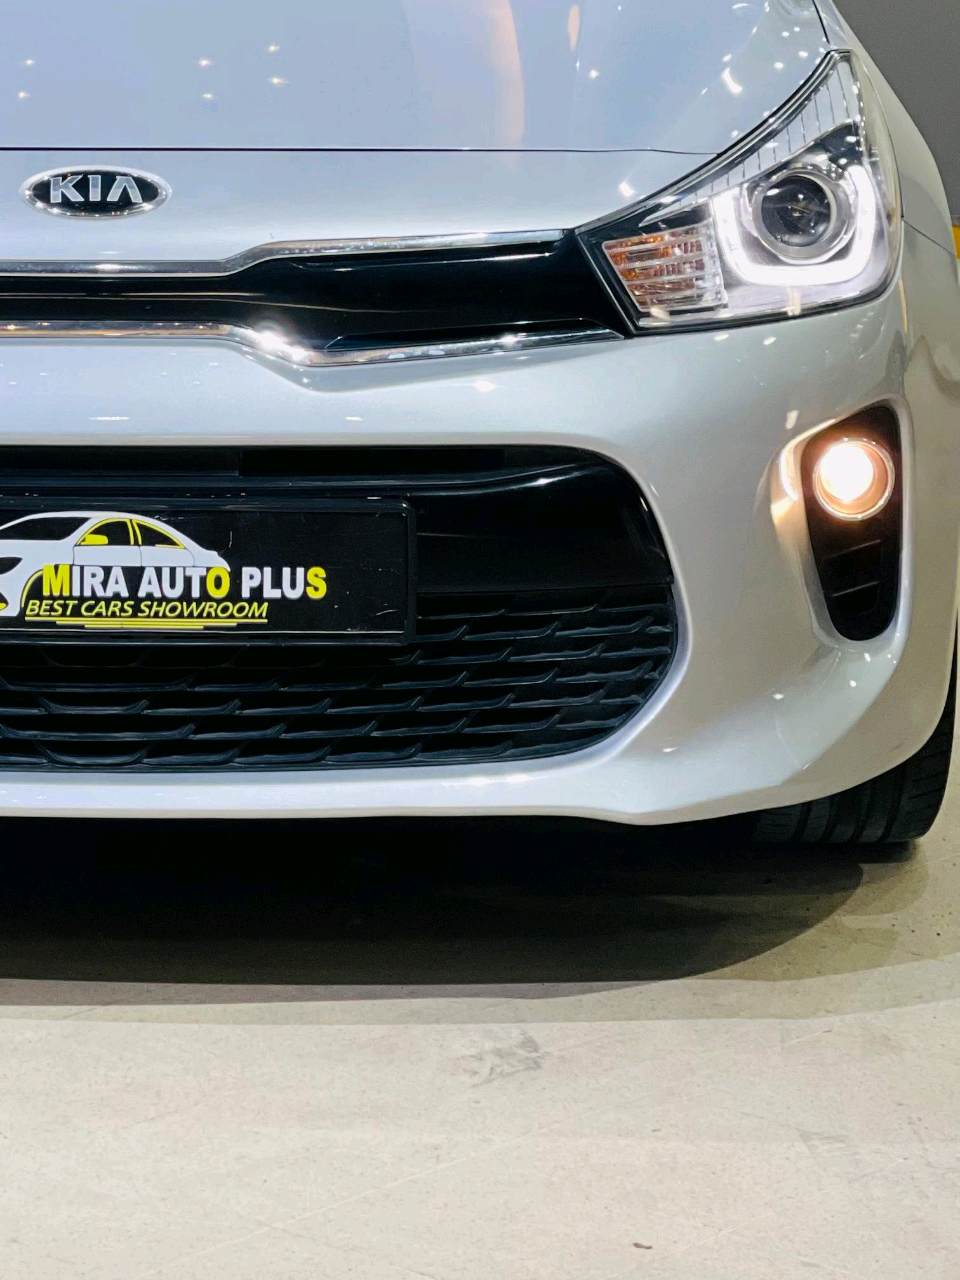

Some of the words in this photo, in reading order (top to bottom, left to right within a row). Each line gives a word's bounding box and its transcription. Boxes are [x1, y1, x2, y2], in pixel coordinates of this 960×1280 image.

[50, 174, 143, 203] KIA
[42, 564, 129, 598] MIRA
[137, 565, 231, 599] AUTO
[241, 566, 327, 600] PLUS
[25, 600, 77, 616] BEST
[80, 600, 134, 617] CARS
[138, 601, 269, 618] SHOWROOM
